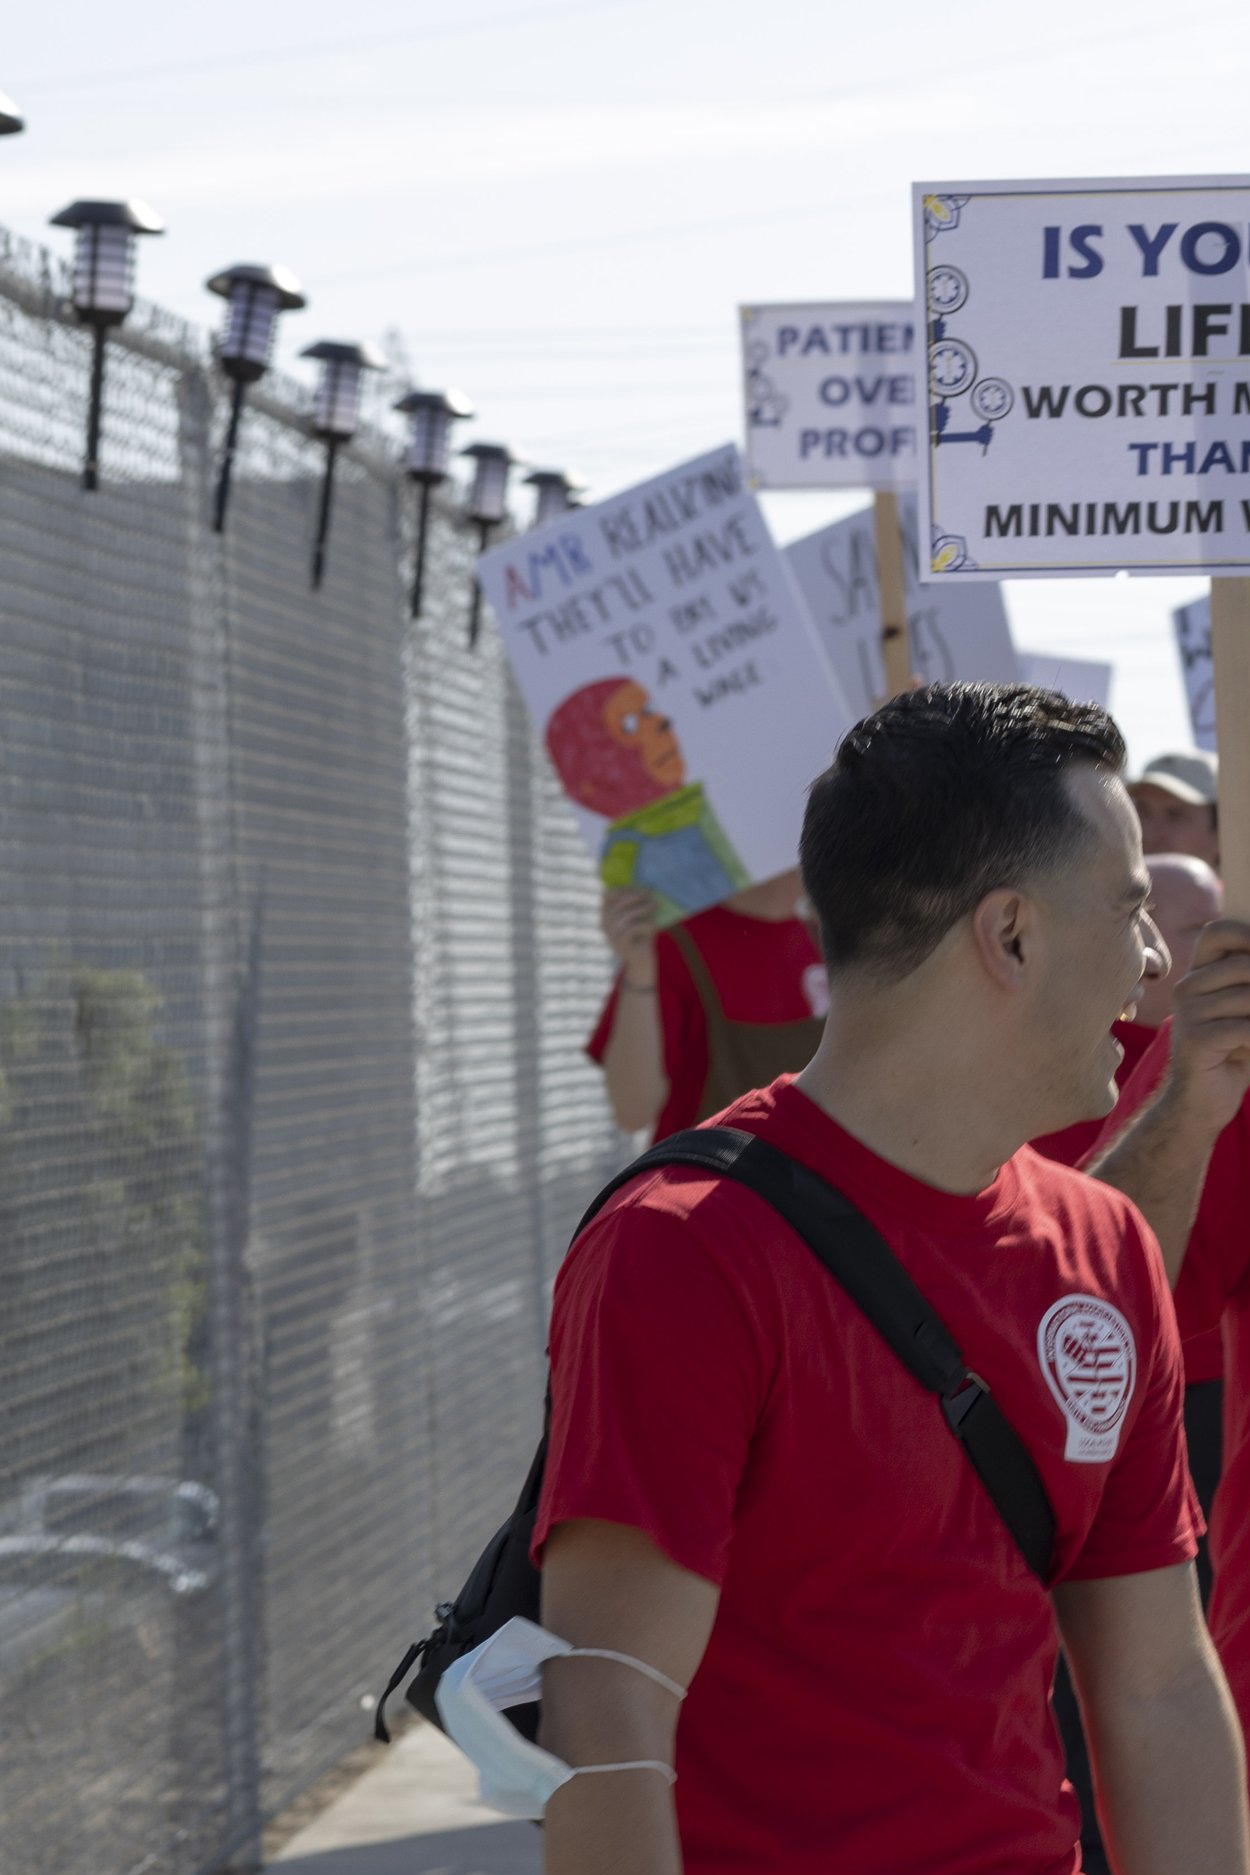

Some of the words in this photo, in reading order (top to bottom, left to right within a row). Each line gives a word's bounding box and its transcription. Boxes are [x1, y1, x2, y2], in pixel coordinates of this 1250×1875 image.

[1041, 224, 1105, 280] IS
[819, 374, 915, 407] OVE
[1021, 382, 1217, 419] WORTH
[799, 425, 916, 460] PROF
[983, 502, 1225, 538] MINIMUM
